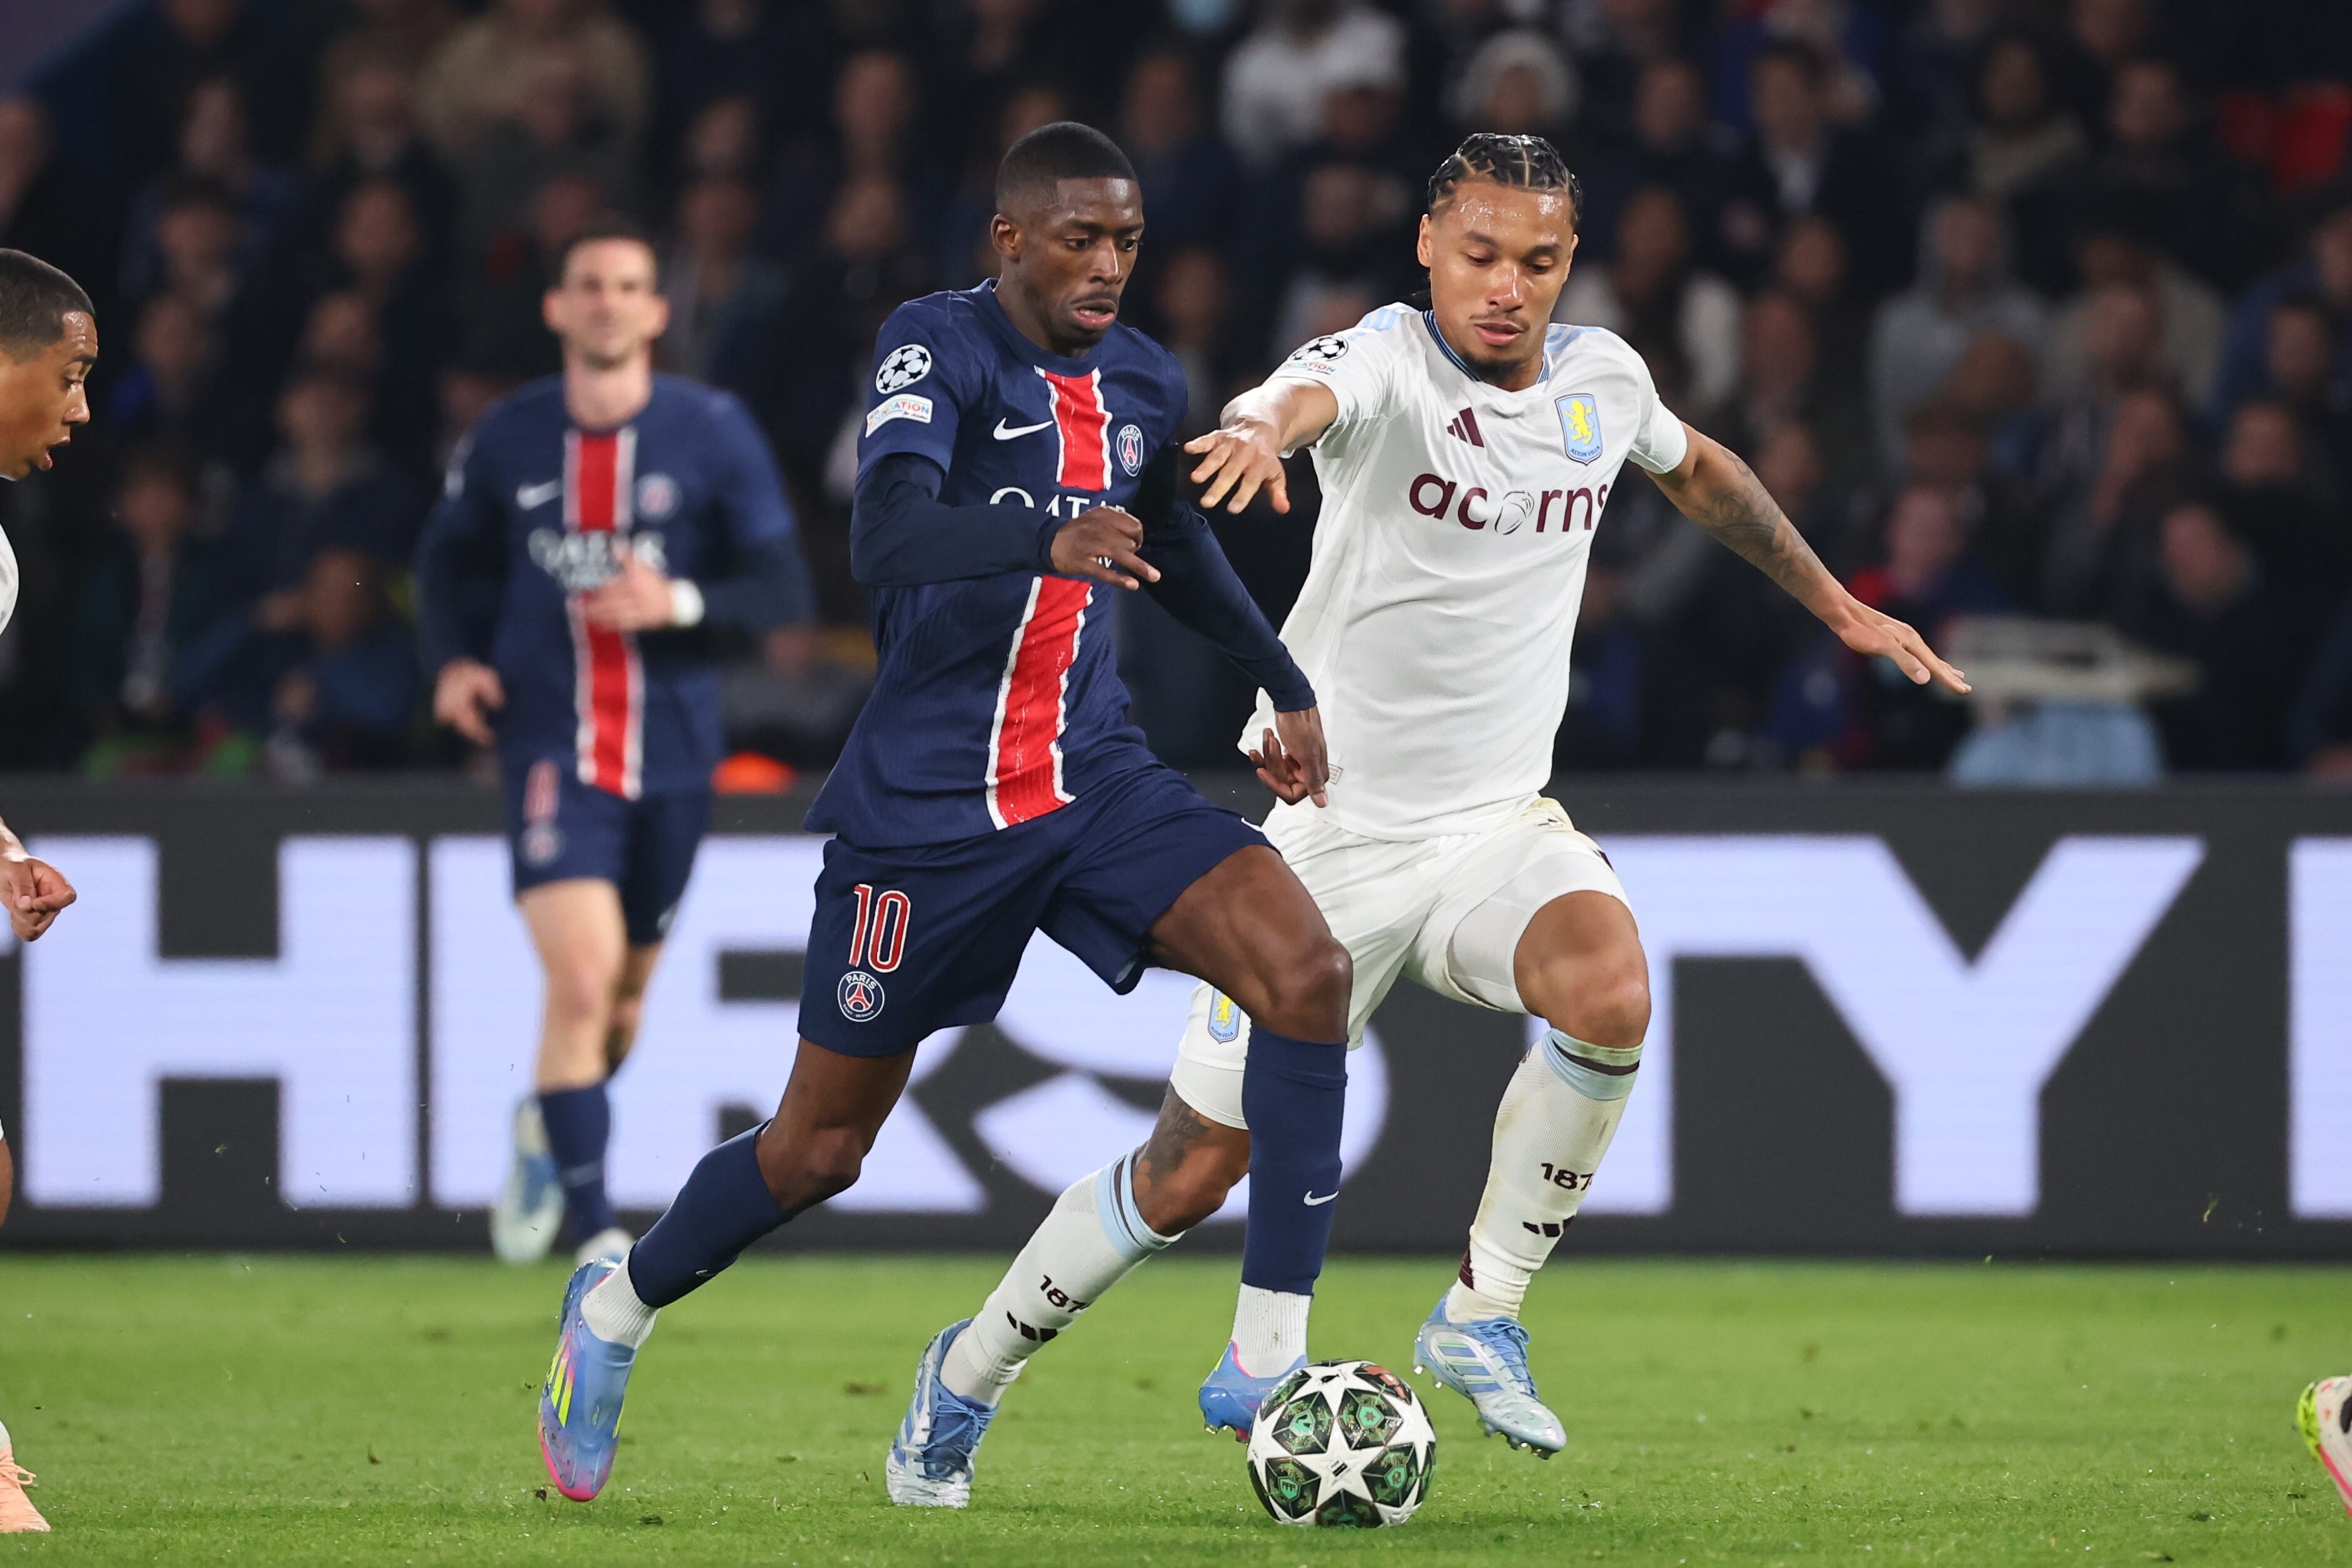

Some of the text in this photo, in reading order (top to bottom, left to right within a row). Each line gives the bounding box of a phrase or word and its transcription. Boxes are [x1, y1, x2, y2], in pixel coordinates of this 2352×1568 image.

[1121, 427, 1140, 441] PARIS
[1571, 446, 1600, 457] ASTON VILLA
[848, 883, 911, 973] 10
[846, 974, 877, 990] PARIS
[1540, 1163, 1594, 1191] 187
[1040, 1274, 1095, 1312] 187
